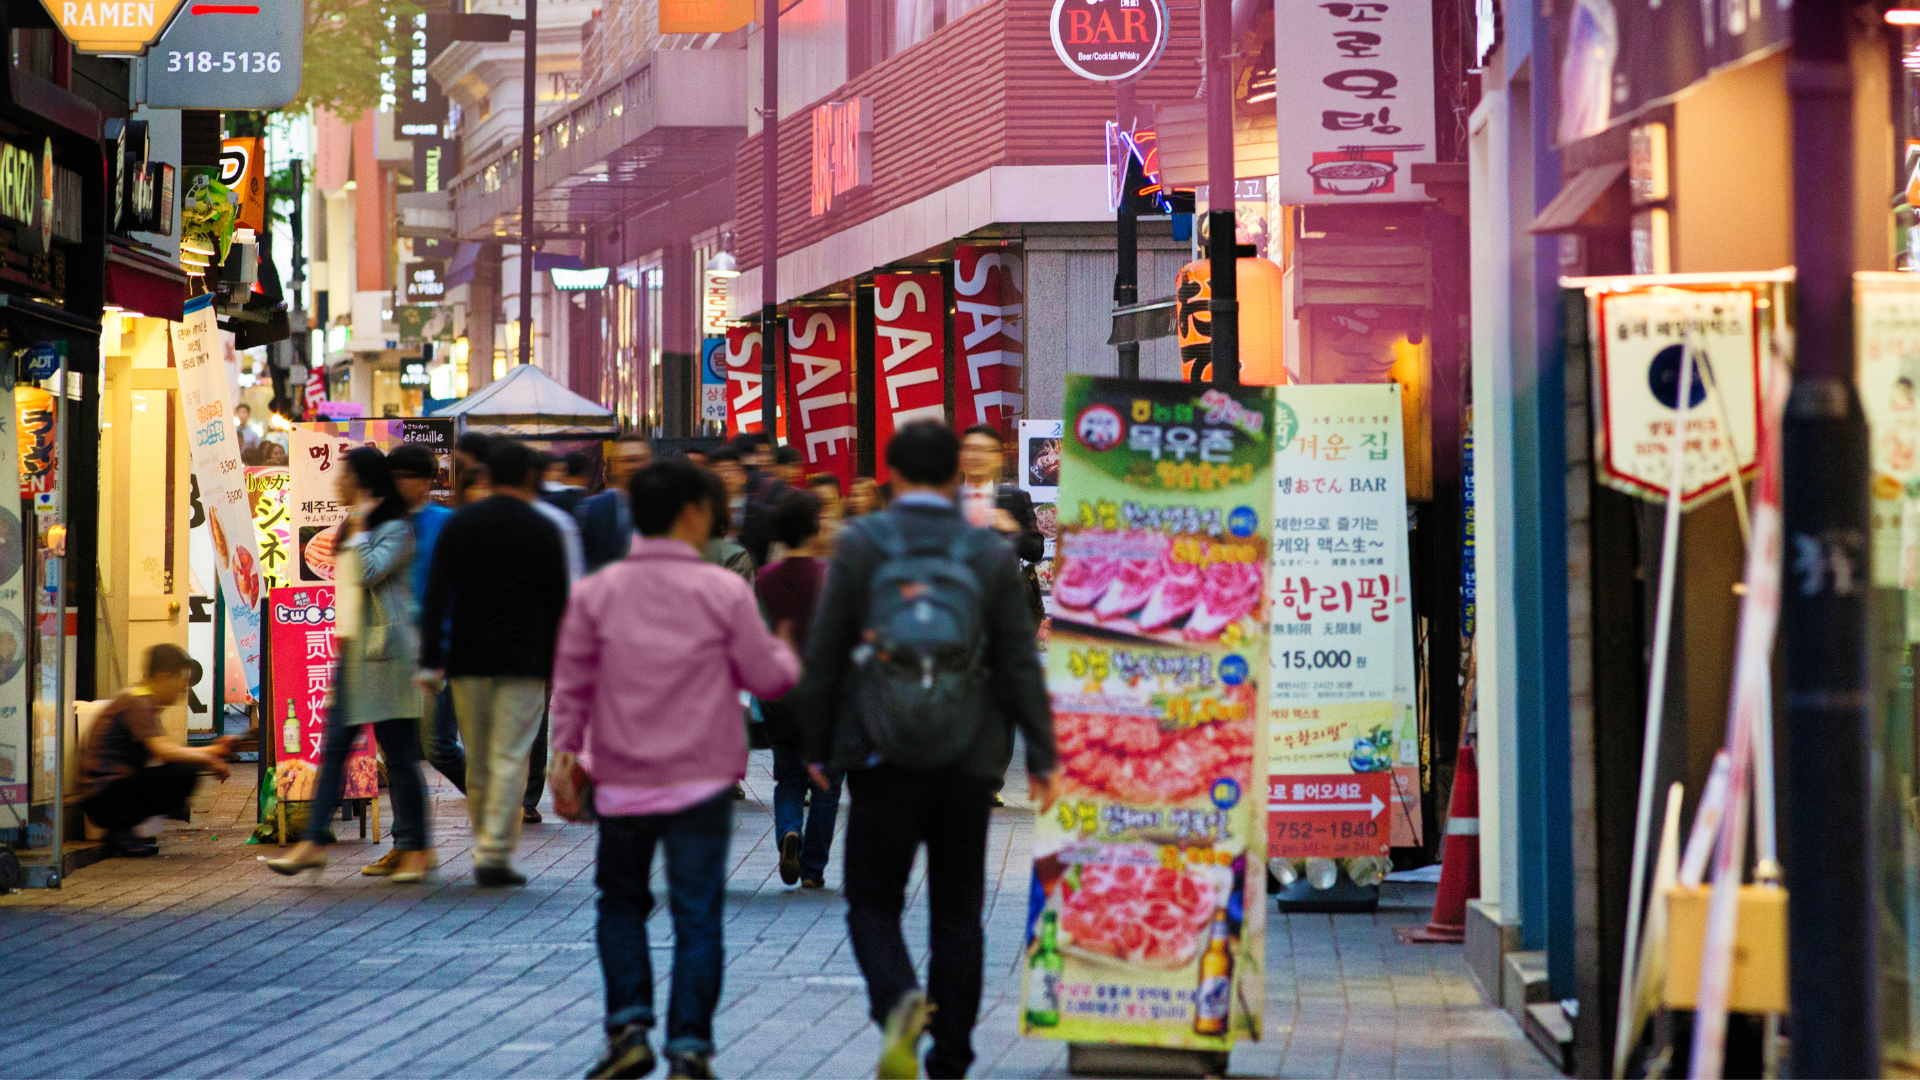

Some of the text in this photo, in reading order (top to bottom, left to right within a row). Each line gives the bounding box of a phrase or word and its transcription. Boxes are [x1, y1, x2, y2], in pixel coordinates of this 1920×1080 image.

[63, 2, 154, 27] RAMEN
[1067, 8, 1151, 44] BAR
[167, 51, 282, 73] 318-5136
[28, 355, 54, 368] ADT
[726, 331, 785, 441] SAL
[789, 312, 851, 463] SALE
[1128, 424, 1234, 462] 목우촌
[1359, 431, 1388, 461] 집
[1349, 478, 1387, 492] BAR
[301, 500, 338, 514] 제주도
[1337, 516, 1379, 532] 즐기는
[1282, 650, 1351, 670] 15,000
[1292, 783, 1361, 800] 들어오세요
[1276, 821, 1378, 839] 752-1840
